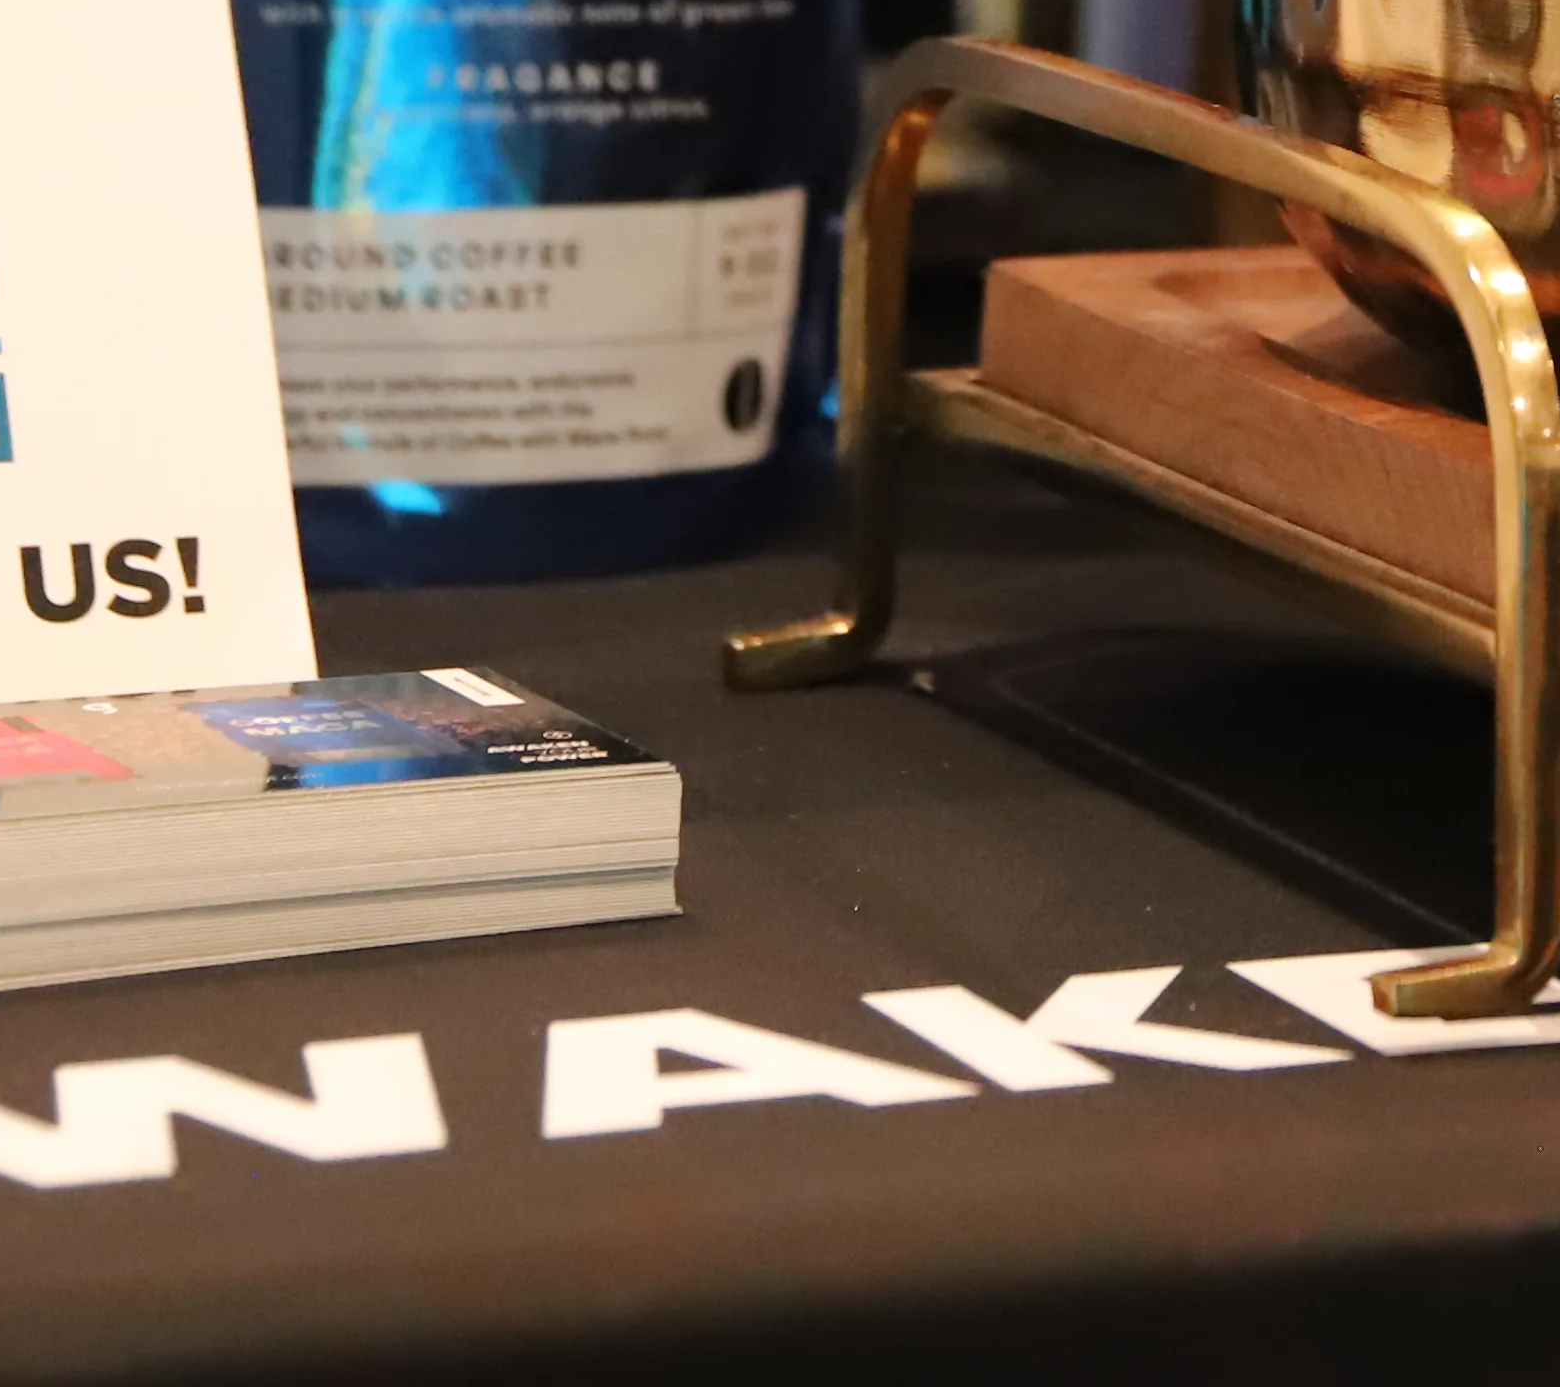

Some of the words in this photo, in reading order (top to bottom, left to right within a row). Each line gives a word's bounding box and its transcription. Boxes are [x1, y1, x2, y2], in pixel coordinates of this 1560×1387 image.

[272, 239, 418, 271] ROUND
[273, 283, 407, 314] EDIUM
[18, 536, 207, 624] US!
